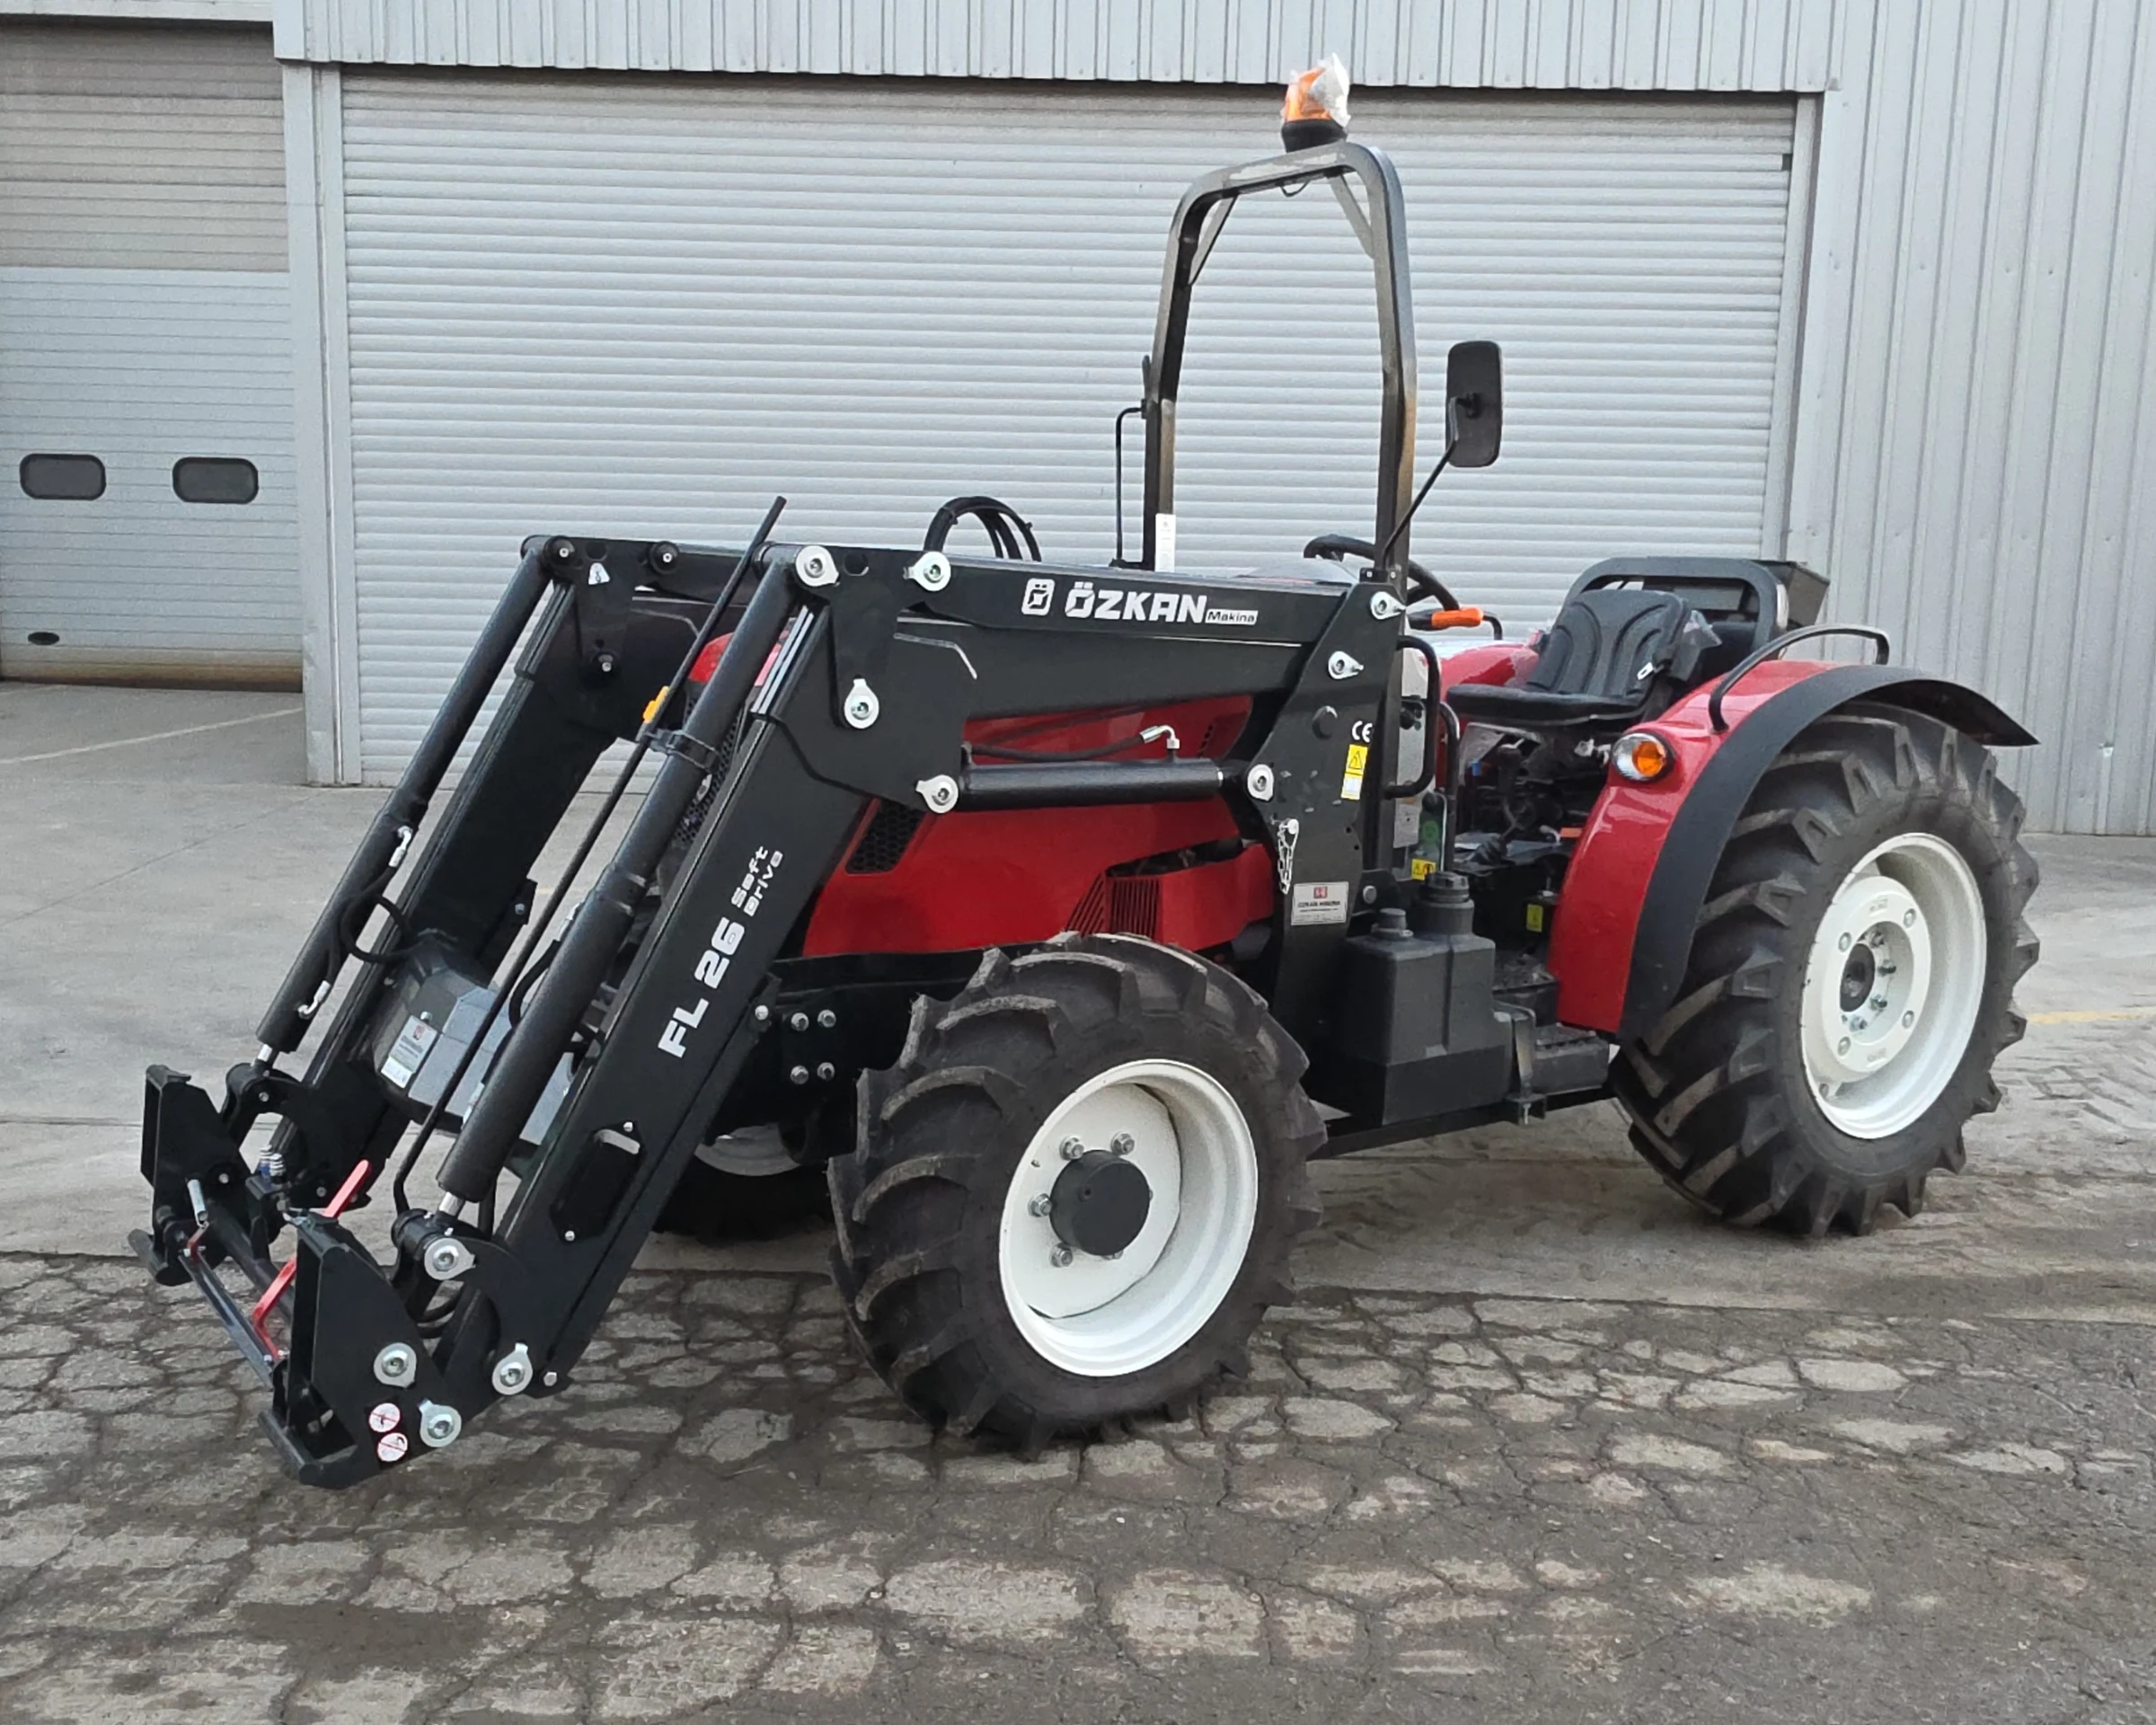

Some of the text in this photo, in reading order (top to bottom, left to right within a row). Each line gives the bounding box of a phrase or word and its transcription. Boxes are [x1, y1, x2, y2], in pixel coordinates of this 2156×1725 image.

[1065, 581, 1256, 624] ÖZKAN Makina
[1351, 721, 1373, 743] CE
[730, 845, 769, 908] Soft
[743, 850, 783, 916] Drive
[658, 916, 746, 1058] FL 26
